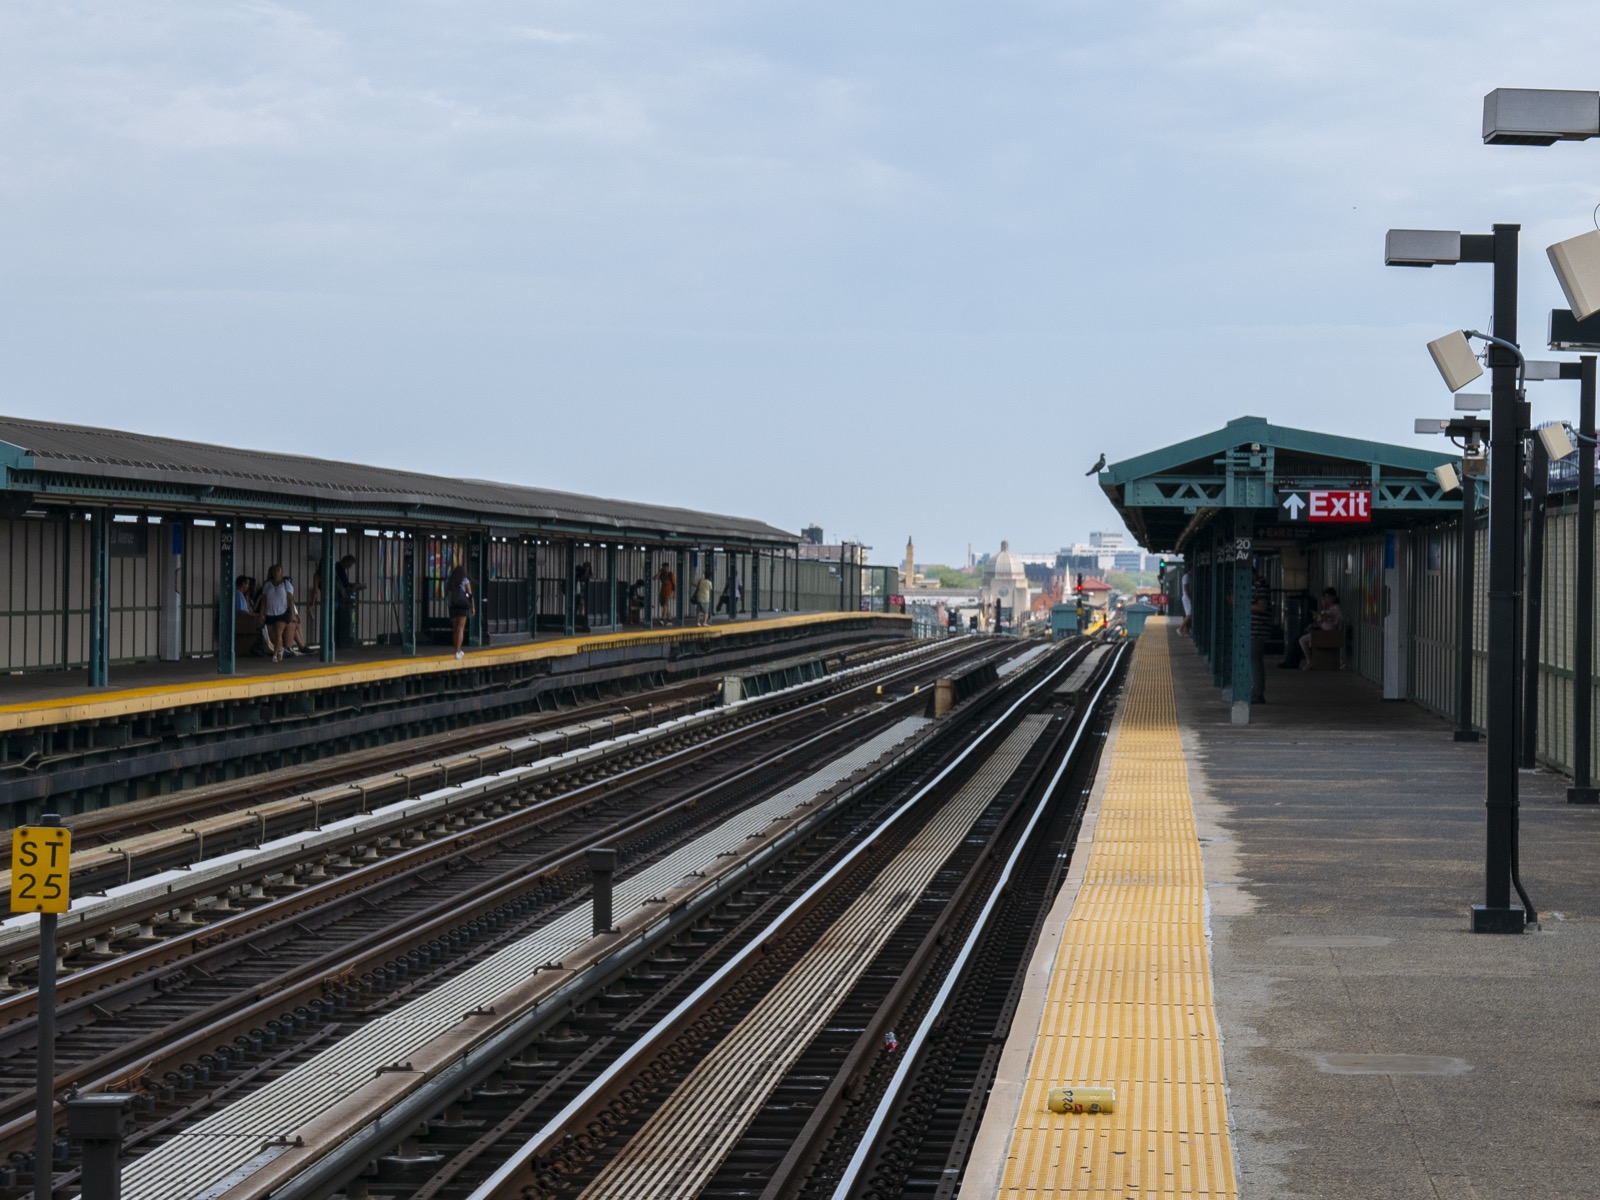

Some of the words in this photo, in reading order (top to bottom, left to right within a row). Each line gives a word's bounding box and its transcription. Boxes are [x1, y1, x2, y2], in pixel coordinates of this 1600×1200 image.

[1310, 491, 1368, 517] Exit
[221, 534, 233, 543] 20
[221, 542, 231, 551] Av
[1236, 539, 1251, 550] 20
[1236, 550, 1249, 561] Av
[19, 841, 63, 867] ST
[18, 873, 62, 899] 25
